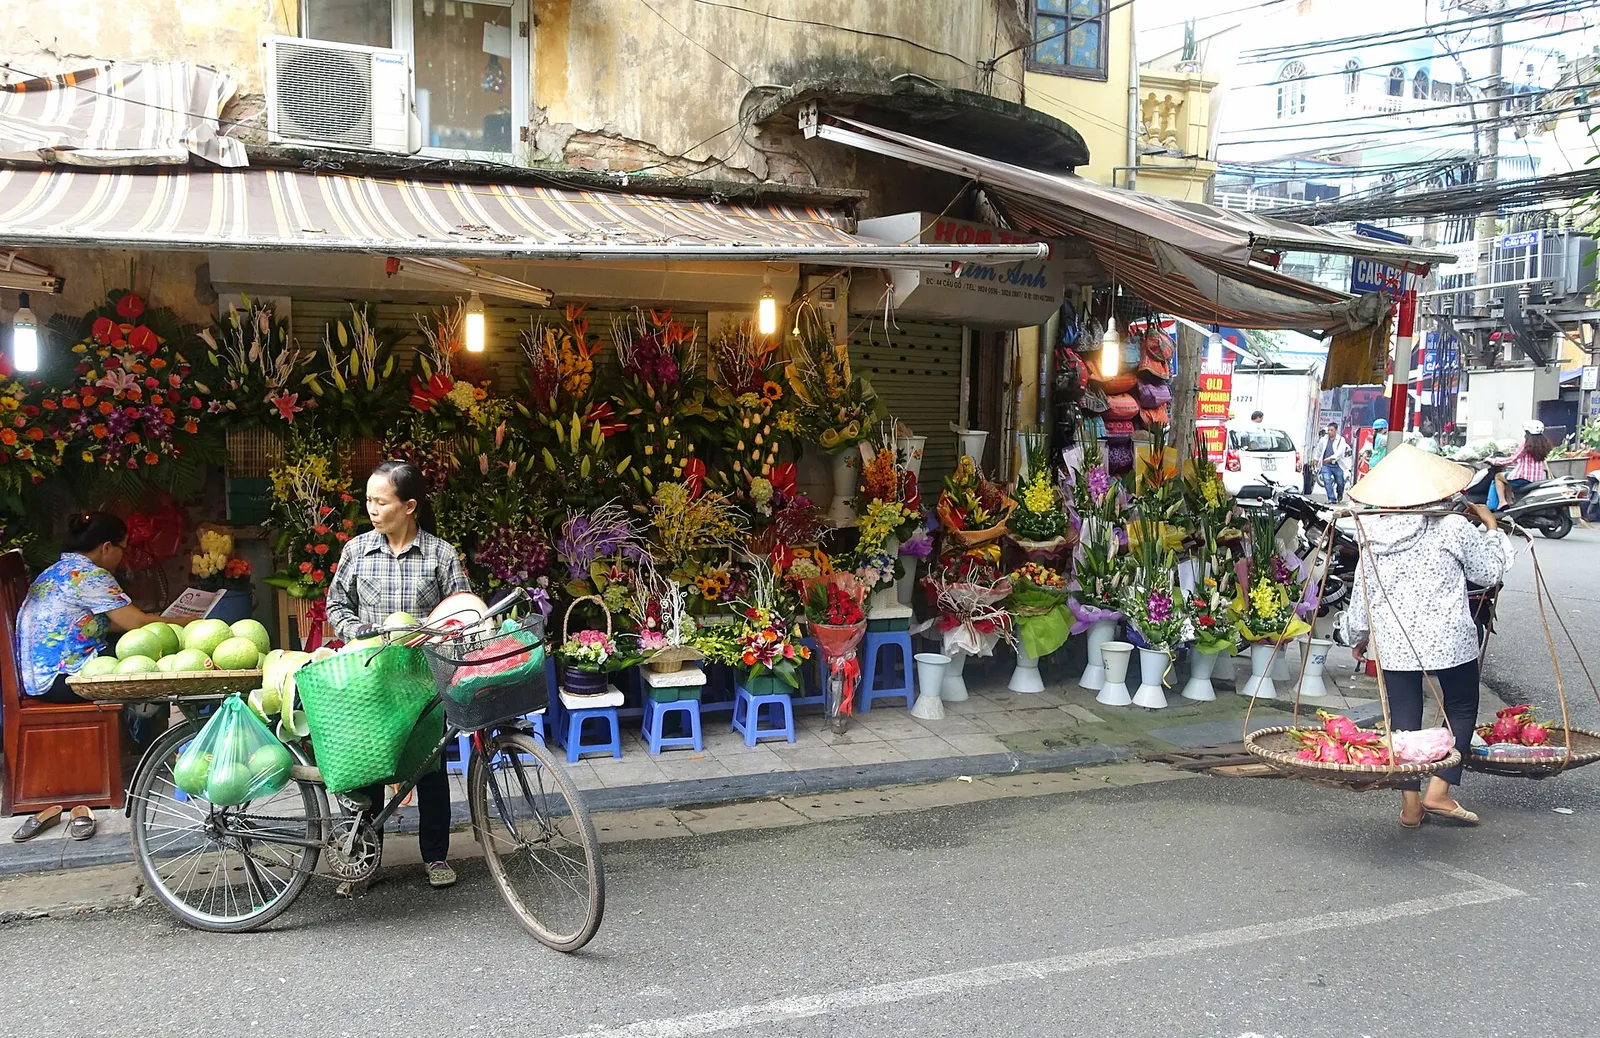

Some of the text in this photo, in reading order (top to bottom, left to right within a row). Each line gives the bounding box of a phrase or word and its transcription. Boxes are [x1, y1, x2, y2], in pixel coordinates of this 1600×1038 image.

[376, 57, 404, 66] Panasonic
[999, 262, 1047, 289] Anh
[1206, 377, 1223, 391] OLD
[1198, 391, 1230, 402] PROPAGANDA
[1201, 403, 1225, 414] POSTERS
